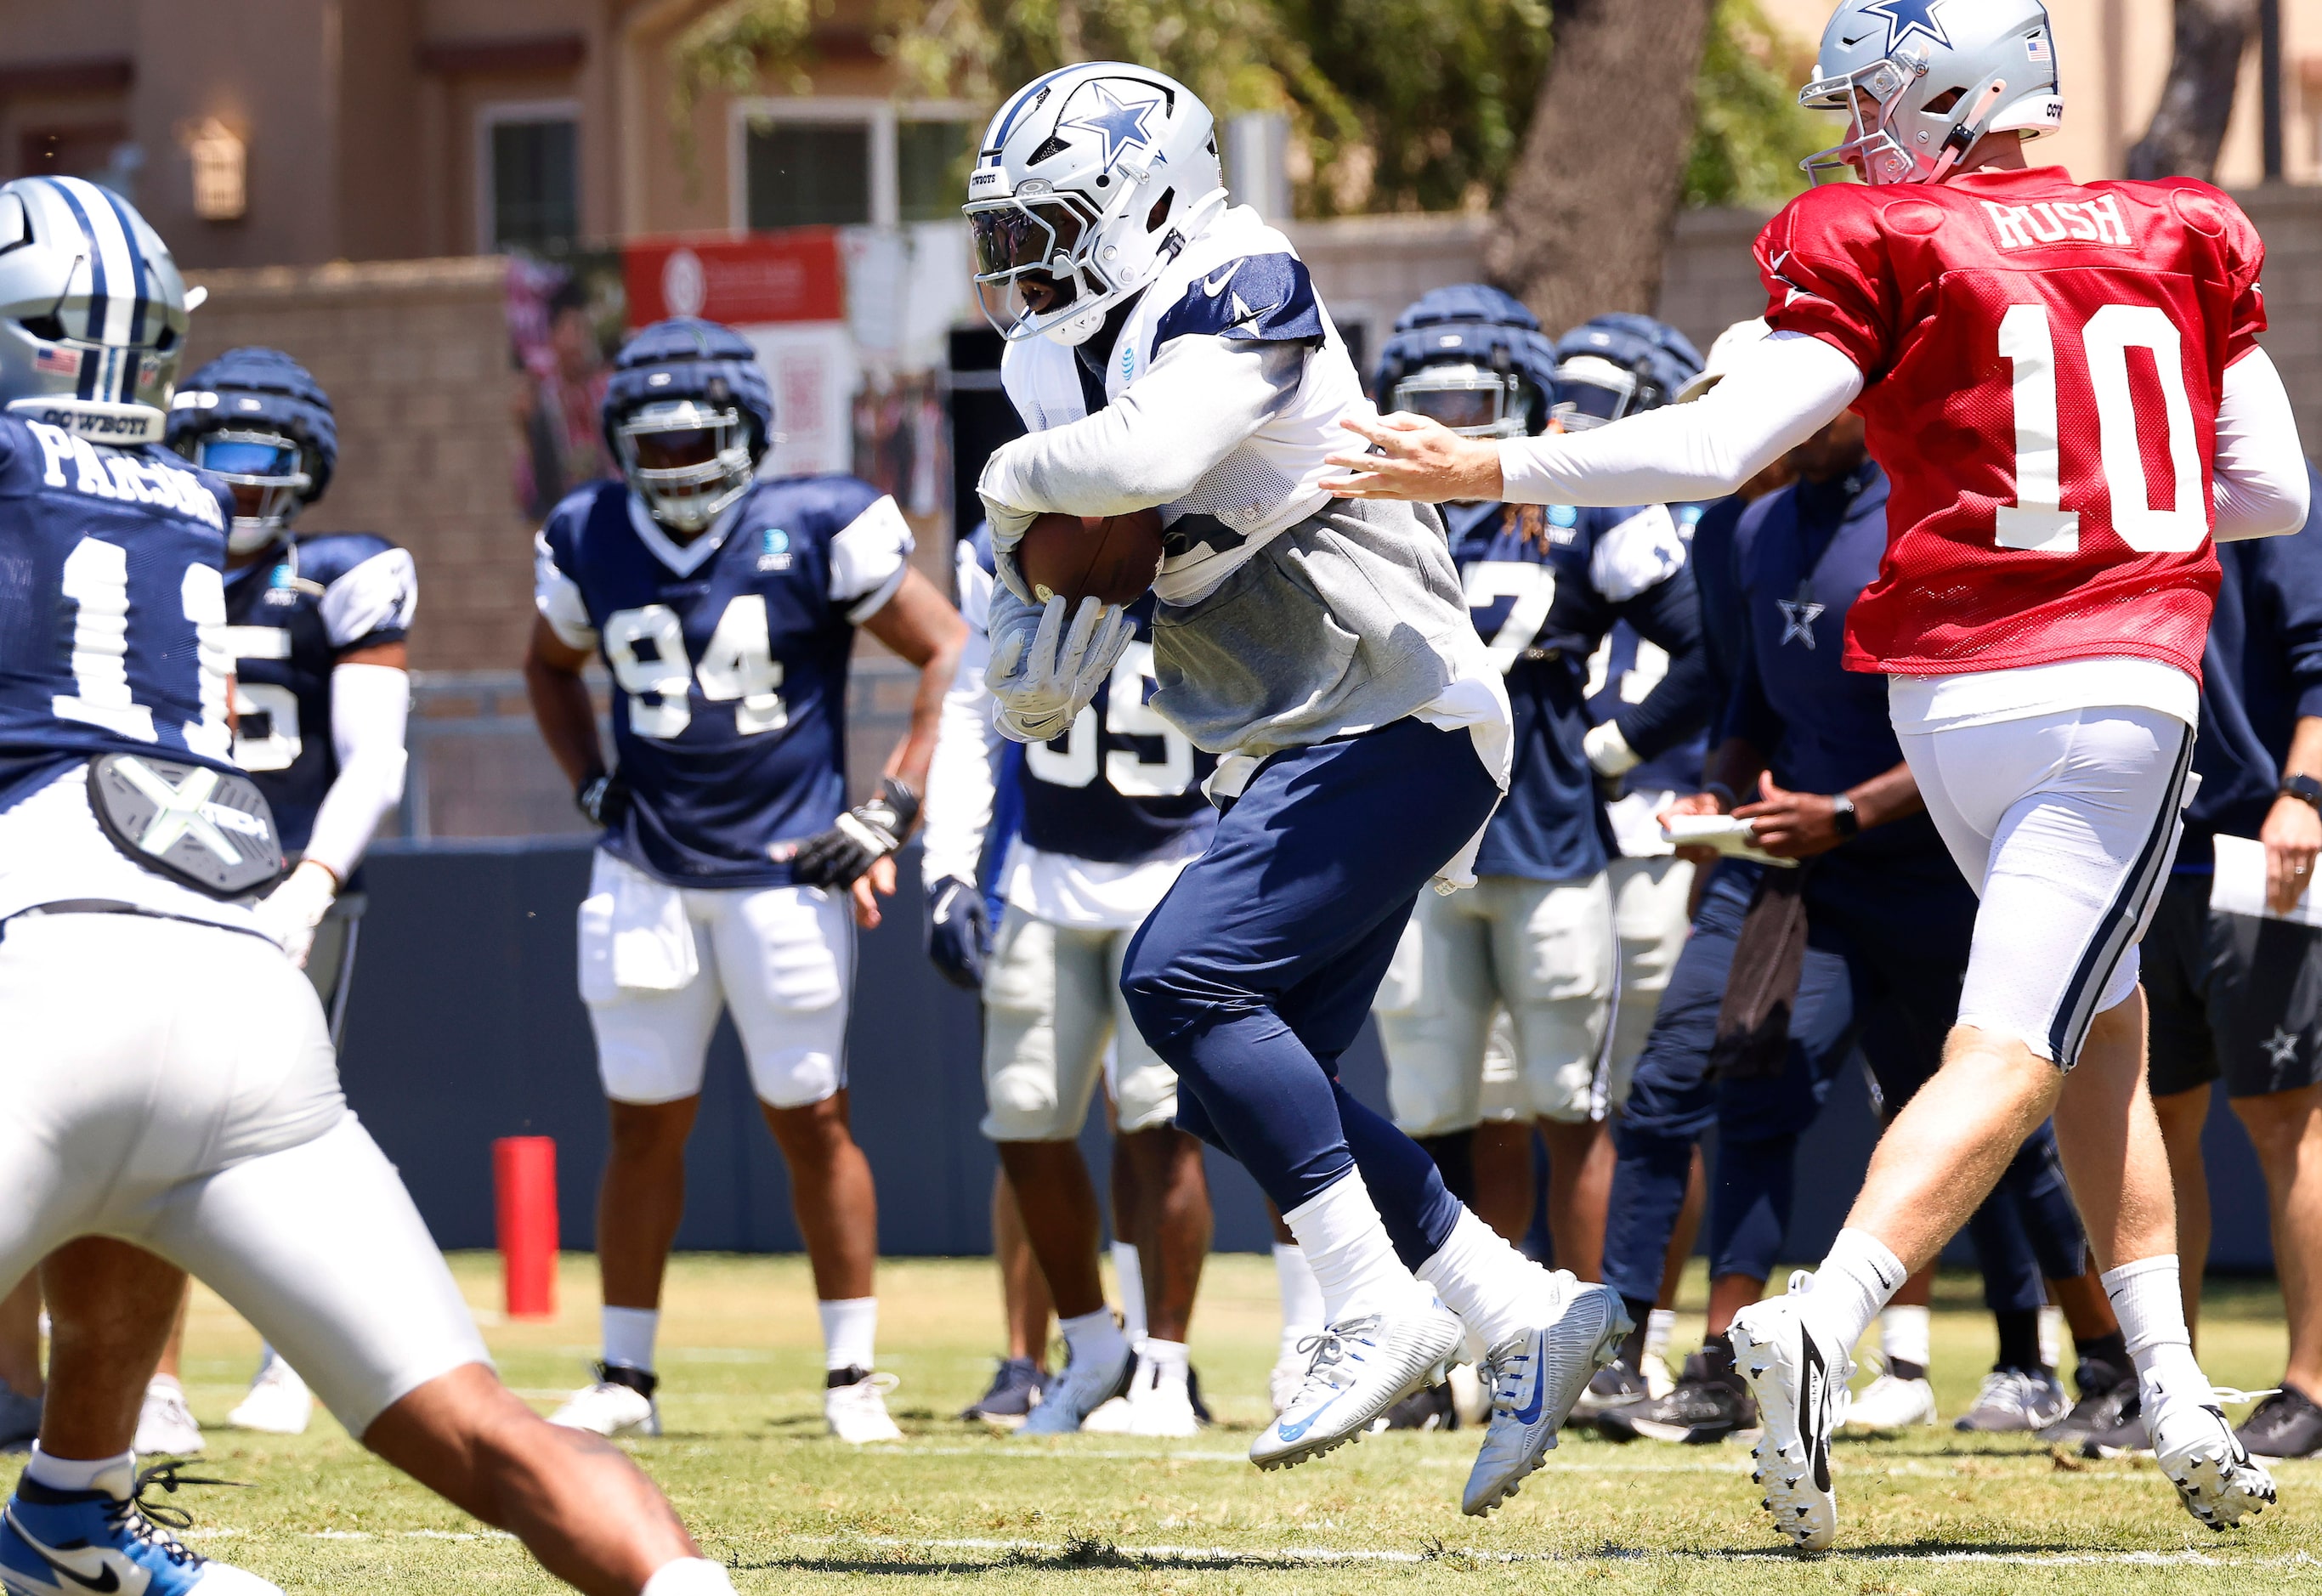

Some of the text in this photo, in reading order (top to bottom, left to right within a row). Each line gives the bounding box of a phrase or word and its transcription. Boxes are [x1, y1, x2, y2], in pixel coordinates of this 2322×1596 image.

[1979, 194, 2132, 248] RUSH
[1995, 303, 2208, 552] 10
[53, 537, 235, 768] 11
[603, 594, 788, 739] 94
